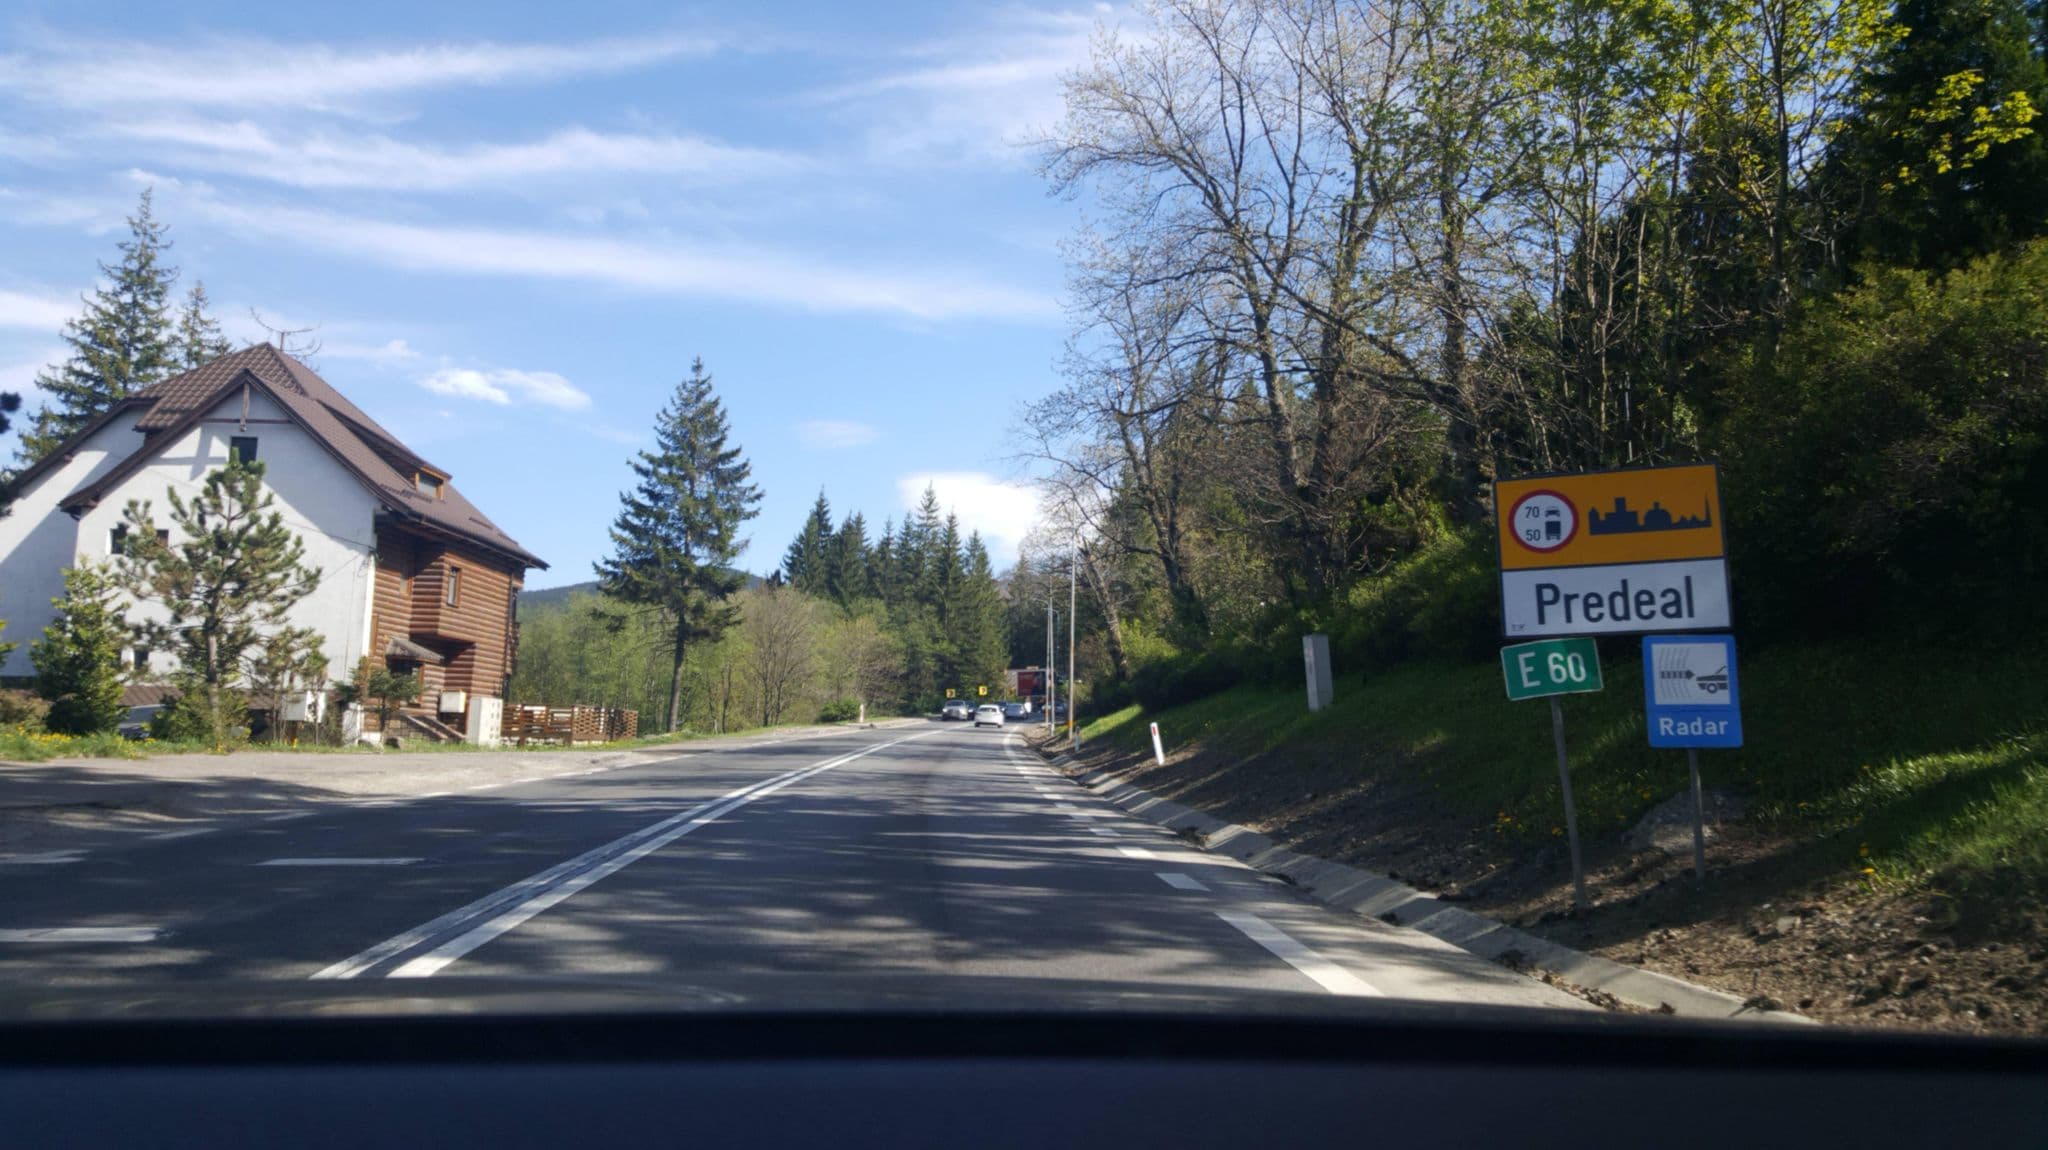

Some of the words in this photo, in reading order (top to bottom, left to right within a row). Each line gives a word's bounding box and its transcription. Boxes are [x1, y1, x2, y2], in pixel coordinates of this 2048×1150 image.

[1525, 506, 1540, 518] 70
[1525, 530, 1540, 542] 50
[1535, 575, 1695, 625] Predeal
[1518, 652, 1540, 688] E
[1548, 652, 1586, 683] 60
[1659, 717, 1728, 736] Radar
